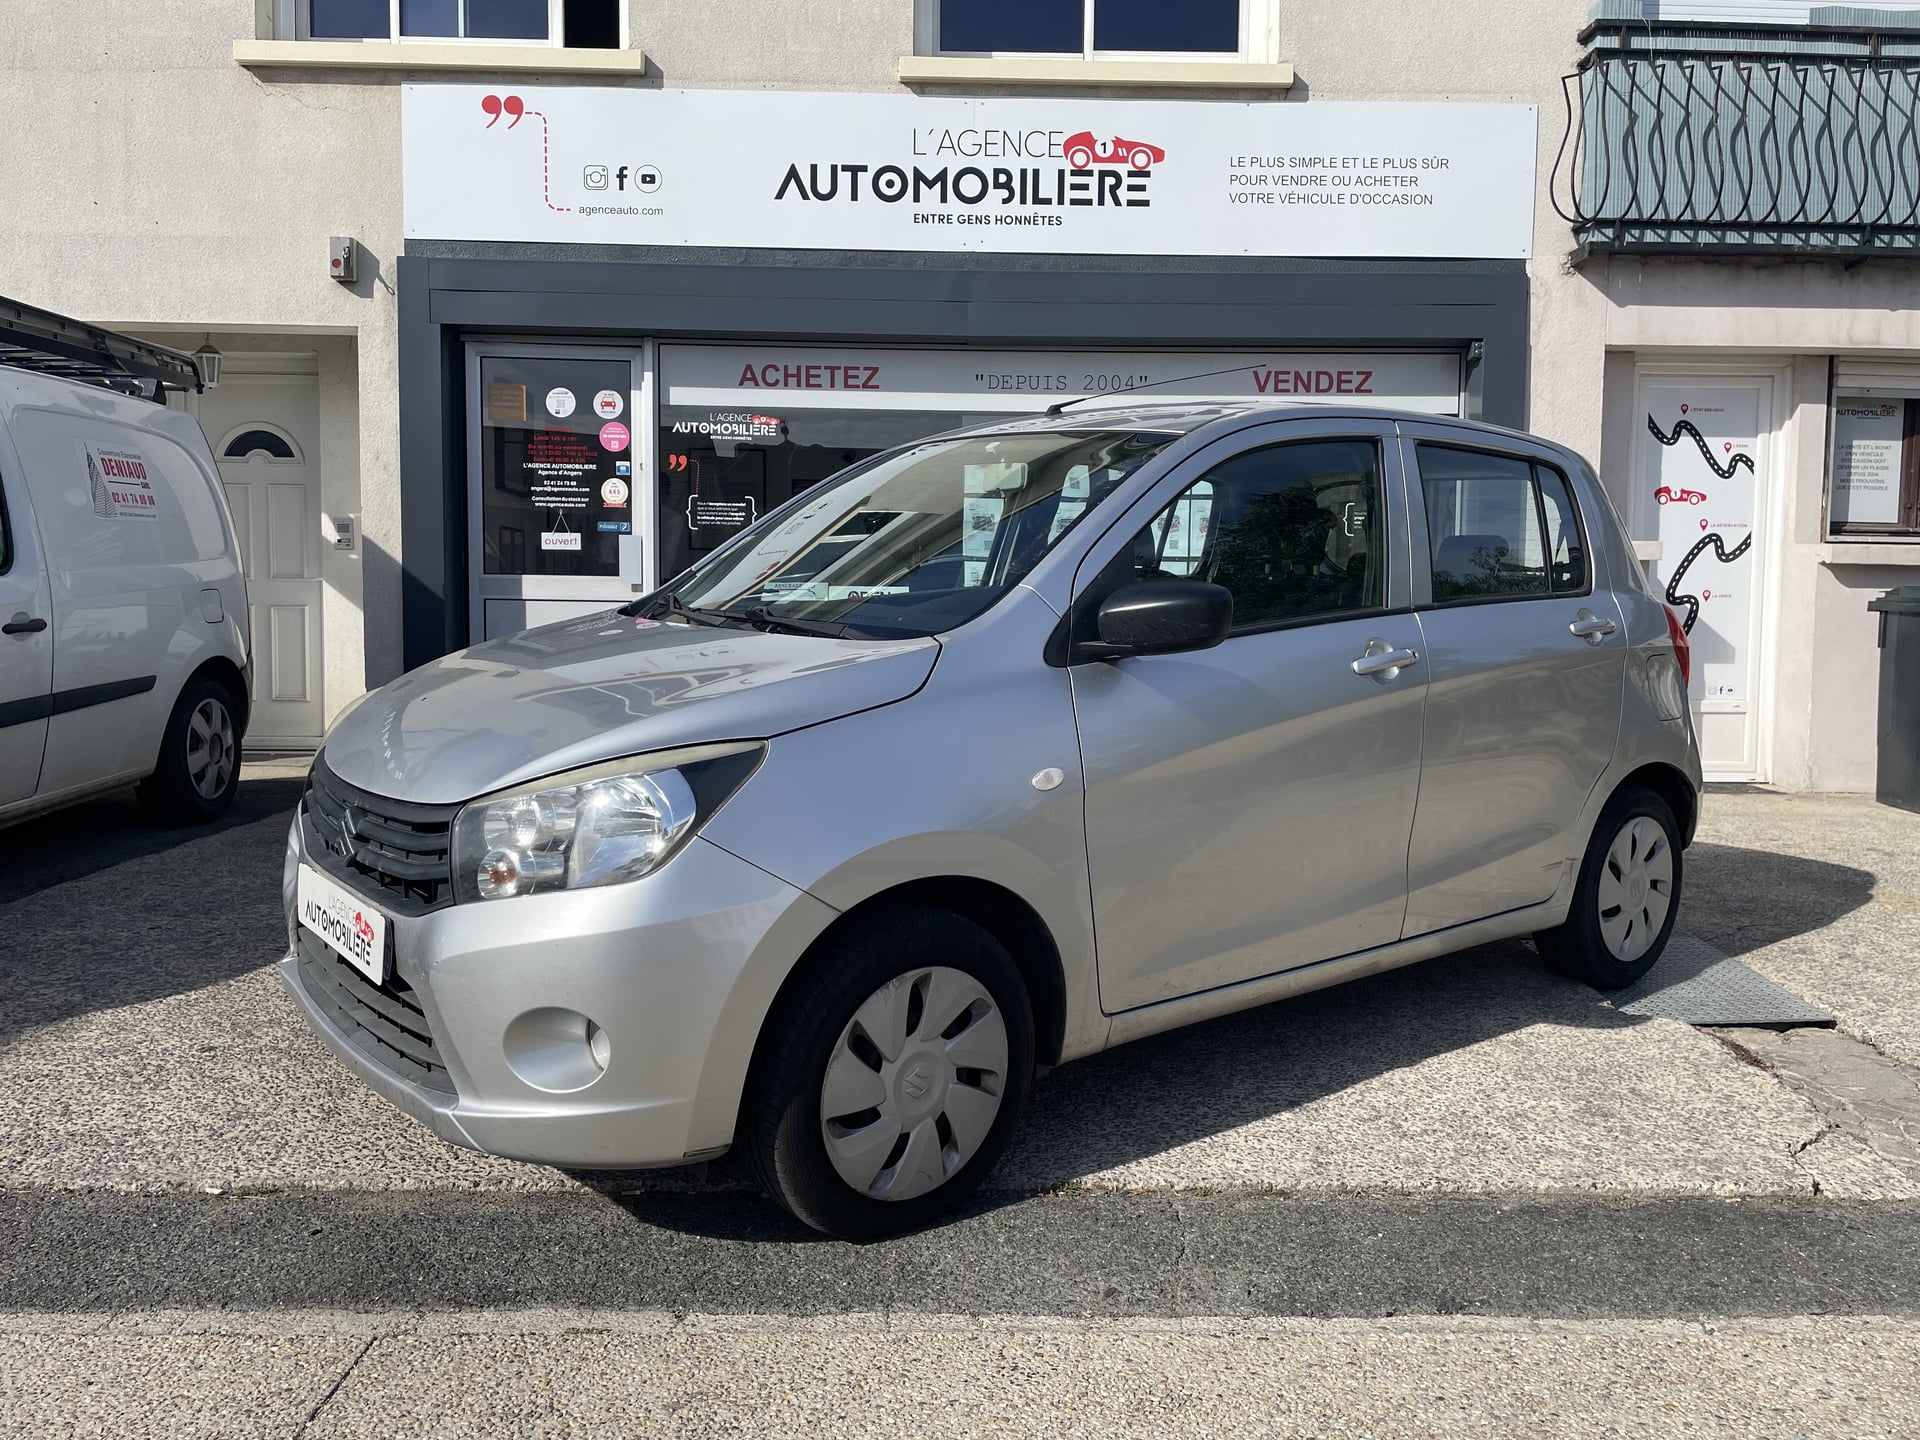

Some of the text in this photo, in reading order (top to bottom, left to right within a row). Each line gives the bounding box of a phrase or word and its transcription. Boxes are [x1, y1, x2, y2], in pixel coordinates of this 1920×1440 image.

[913, 128, 1063, 158] L'AGENCE
[1230, 156, 1450, 169] LE PLUS SIMPLE ET LE PLUS SÛR
[1229, 175, 1419, 187] POUR VENDRE OU ACHETER
[1229, 191, 1433, 205] VOTRE VÉHICULE D'OCCASION
[579, 205, 664, 216] agenceauto.com
[913, 211, 1062, 227] ENTRE GENS HONNÊTES
[738, 364, 880, 390] ACHETEZ
[975, 374, 1149, 391] "DEPUIS 2004"
[1252, 370, 1373, 394] VENDEZ
[709, 412, 752, 422] L'AGENCE
[100, 457, 147, 480] DENIAUD
[544, 537, 577, 546] ouvert
